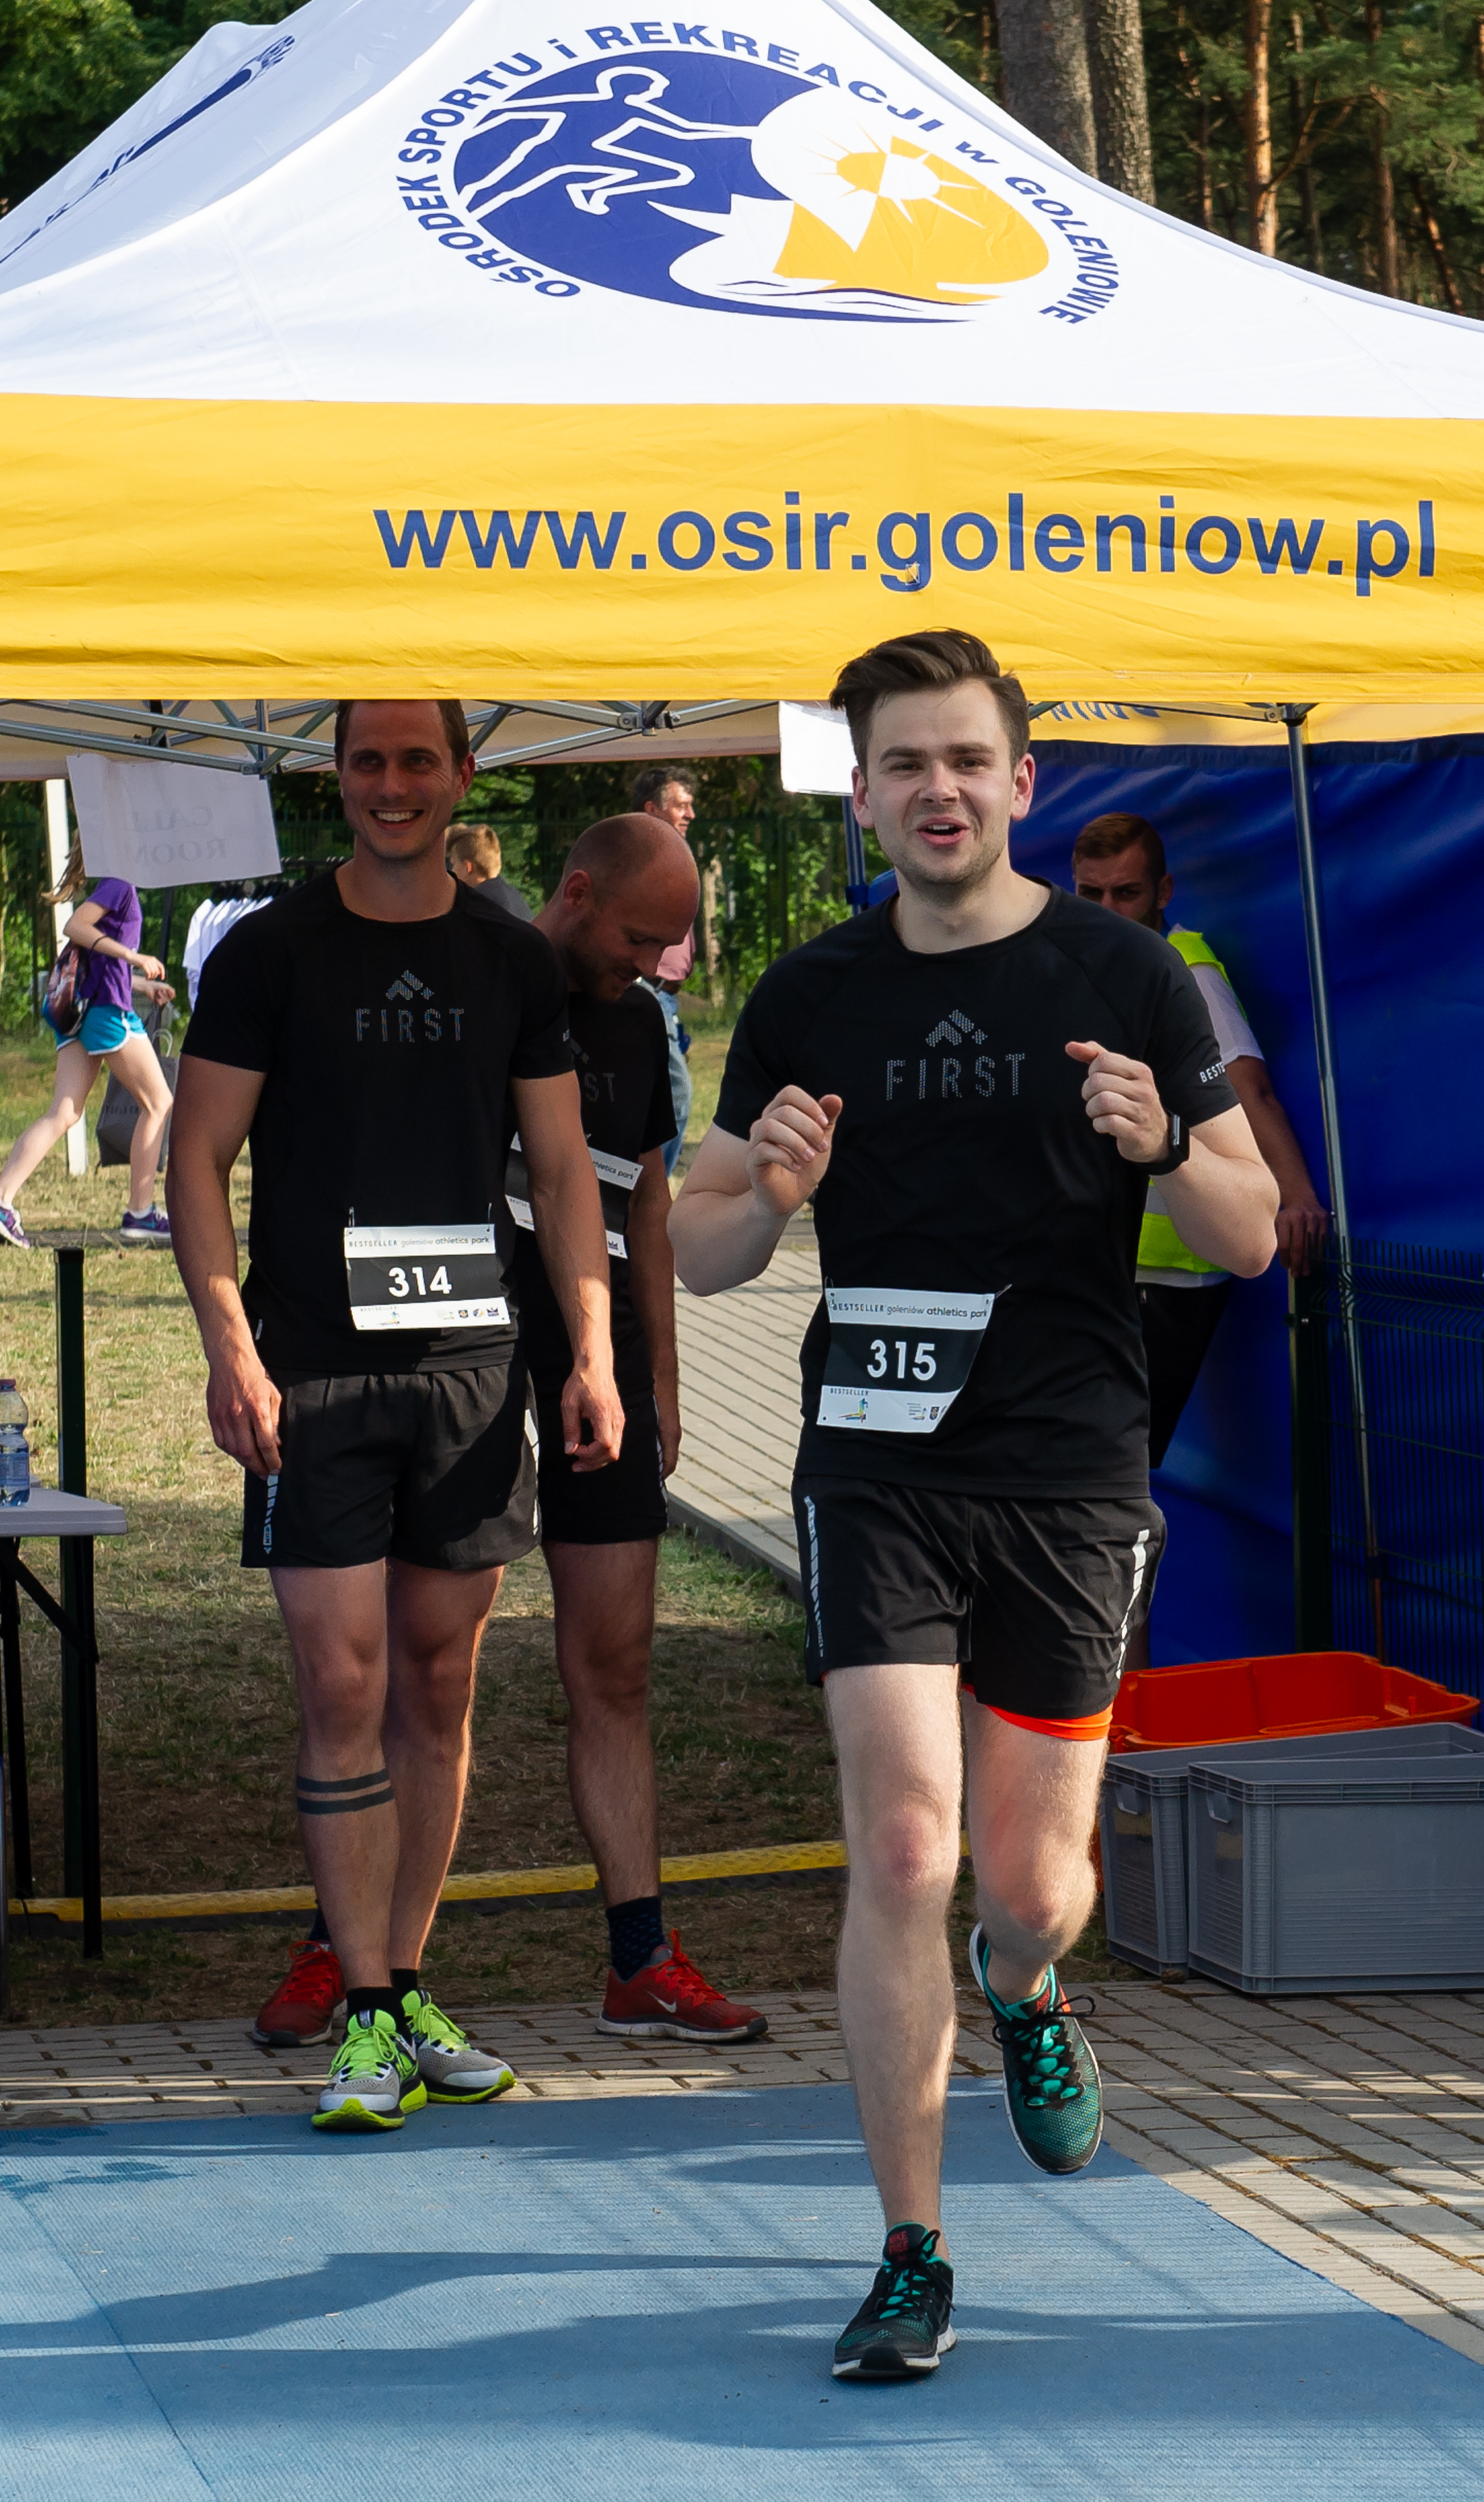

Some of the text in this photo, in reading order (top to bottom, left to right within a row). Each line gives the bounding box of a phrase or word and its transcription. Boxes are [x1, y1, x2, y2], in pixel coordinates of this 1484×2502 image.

[547, 39, 578, 59] i
[585, 22, 944, 132] REKREACJI
[398, 52, 542, 164] SPORTU
[396, 175, 581, 297] OŚRODEK
[1005, 176, 1119, 324] GOLENIOWIE
[373, 491, 1436, 597] www.osir.goleniow.pl
[356, 1008, 465, 1042] FIRST
[886, 1053, 1025, 1100] FIRST
[349, 1239, 398, 1248] BESTSELLER
[435, 1237, 469, 1245] athletics
[471, 1235, 490, 1245] park
[388, 1265, 452, 1297] 314
[833, 1303, 884, 1313] BESTSELLER
[927, 1306, 968, 1317] athletics
[970, 1309, 988, 1320] park
[867, 1339, 937, 1381] 315
[830, 1387, 869, 1396] BESTSELLER
